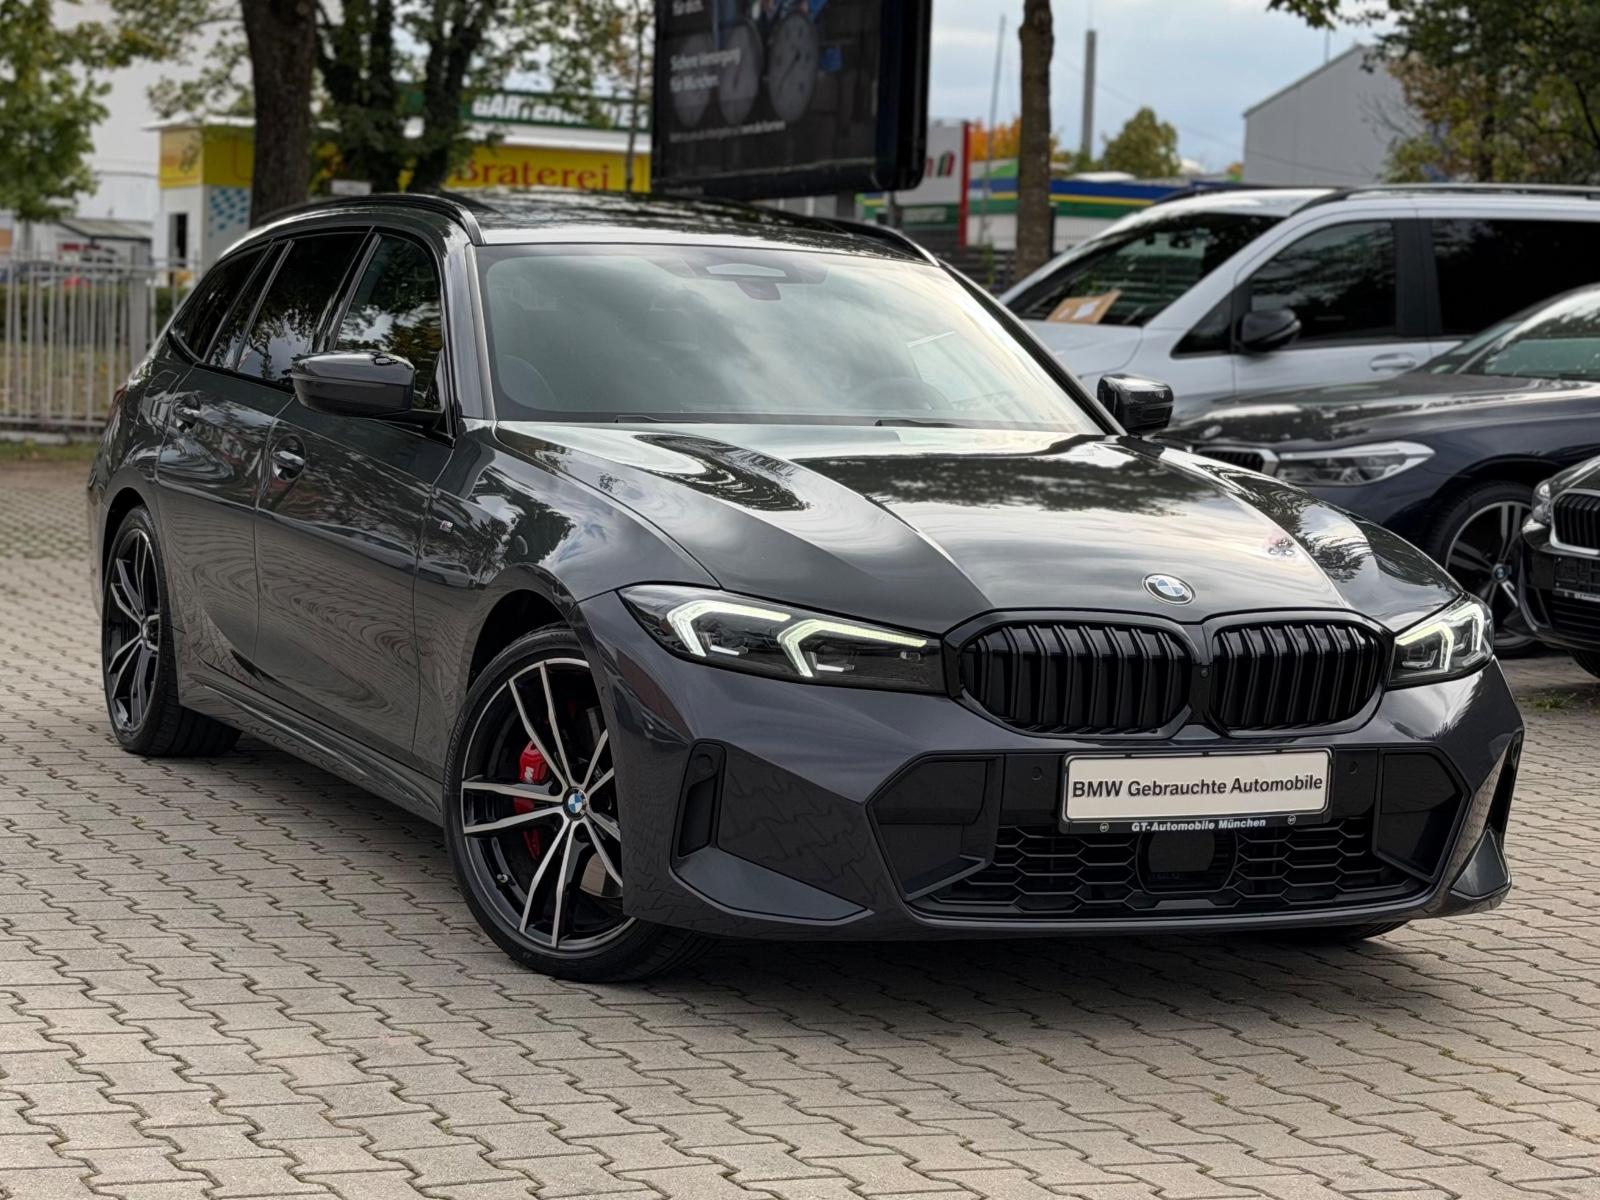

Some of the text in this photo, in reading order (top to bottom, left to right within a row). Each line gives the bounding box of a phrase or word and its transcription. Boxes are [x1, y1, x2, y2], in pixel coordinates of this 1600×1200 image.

[1072, 774, 1323, 798] BMW Gebrauchte Automobile
[1131, 818, 1267, 833] GT-Automobile München
